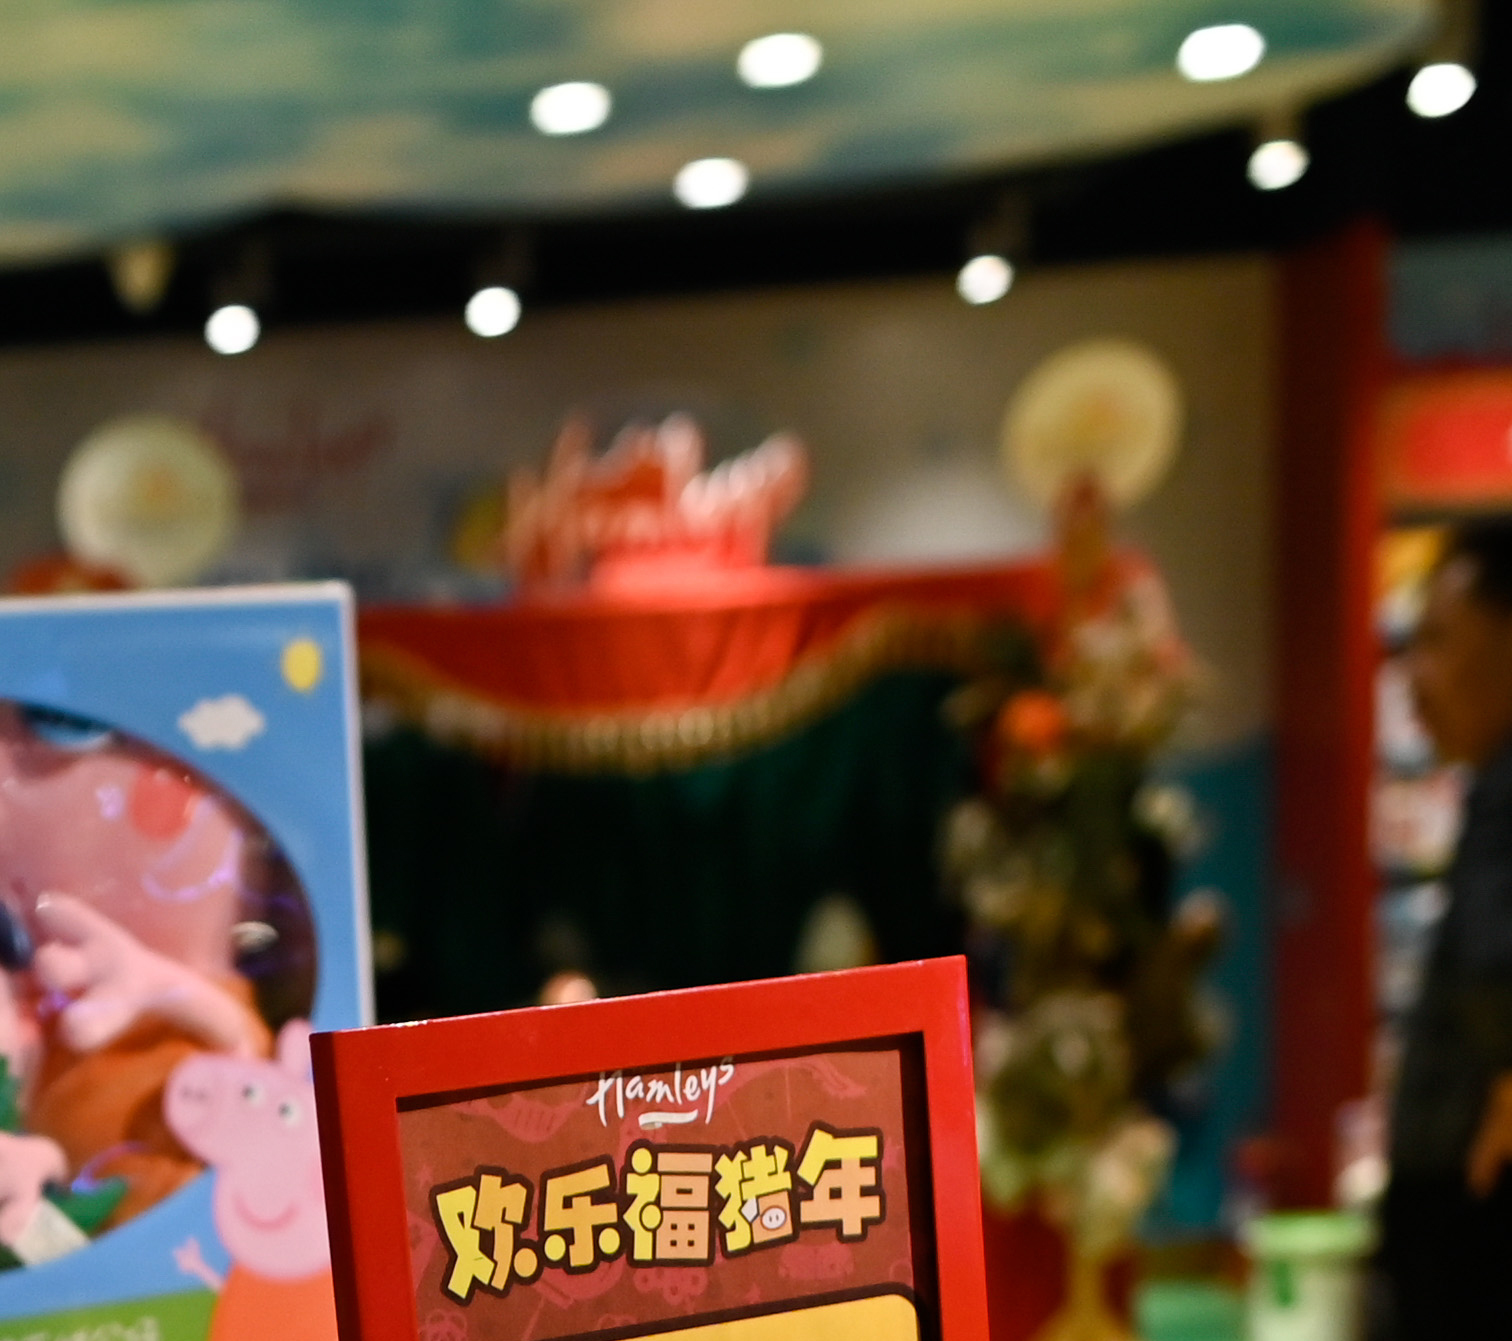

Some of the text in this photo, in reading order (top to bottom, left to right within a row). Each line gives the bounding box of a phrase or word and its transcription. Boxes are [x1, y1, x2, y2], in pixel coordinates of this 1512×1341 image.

[587, 1056, 735, 1129] Hamleys
[436, 1128, 883, 1300] 欢乐福猪年
